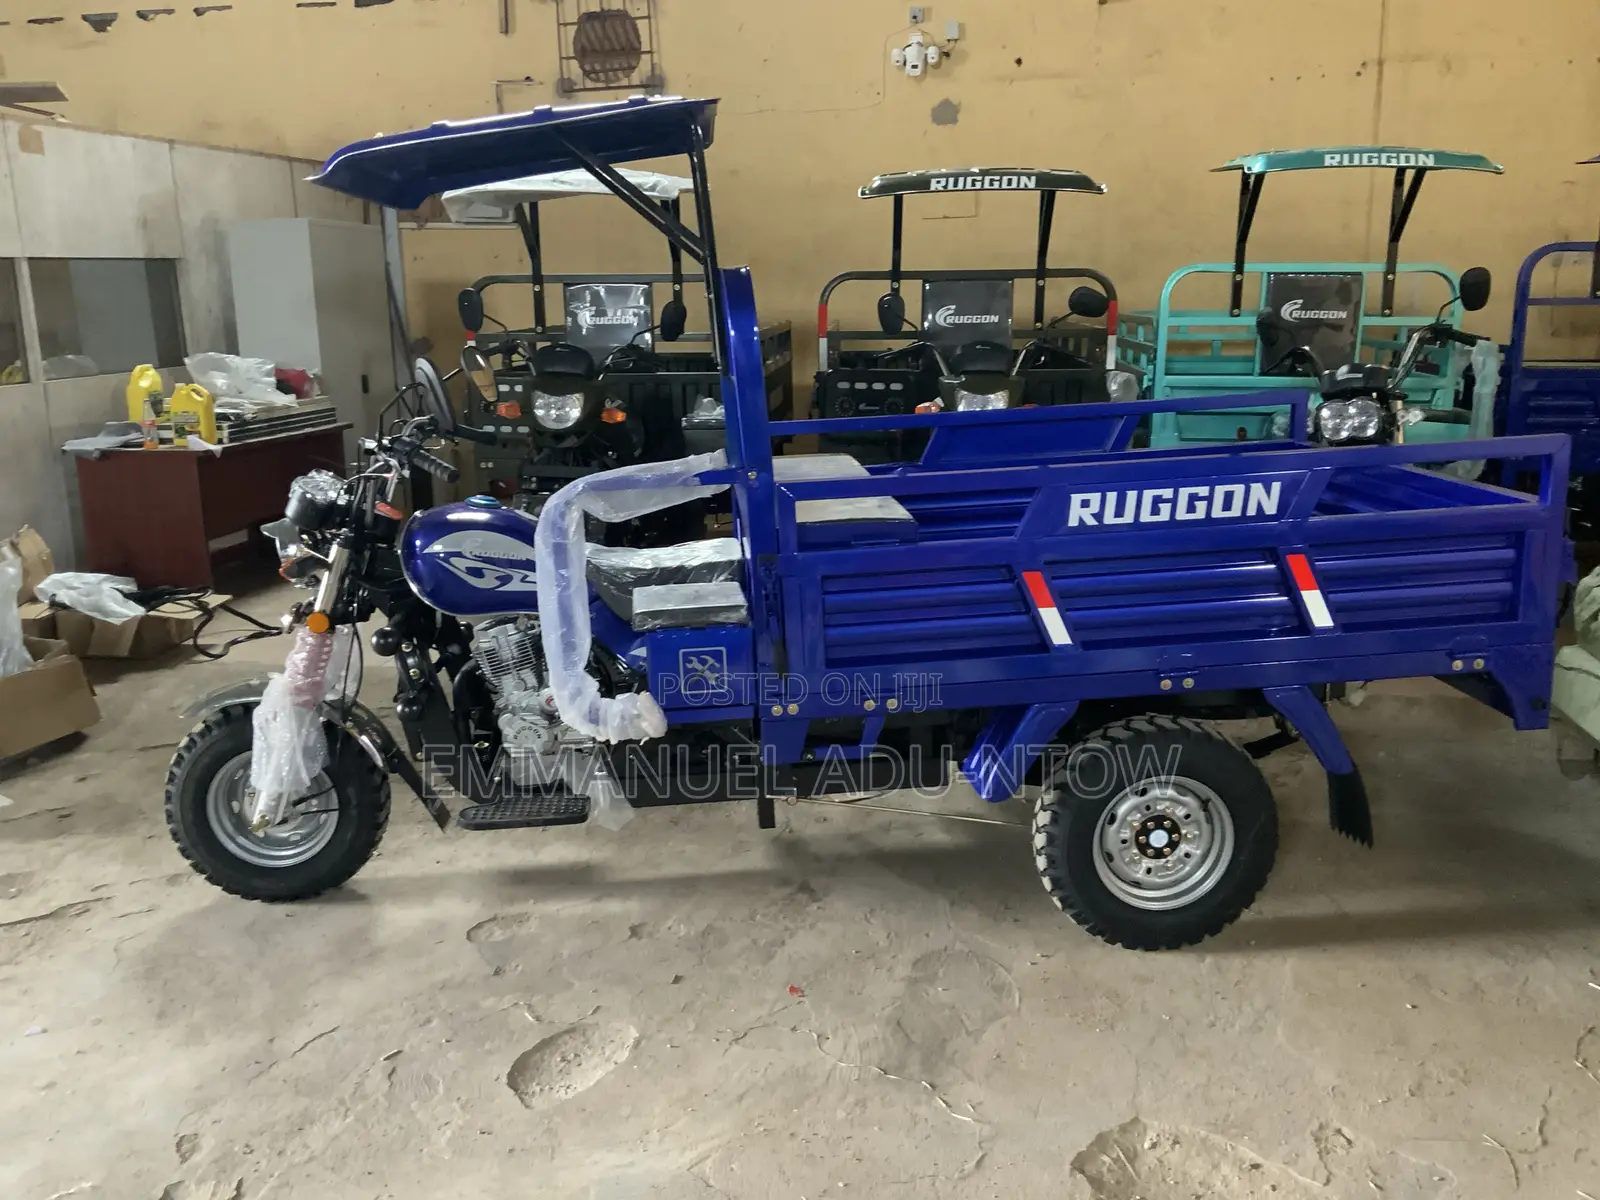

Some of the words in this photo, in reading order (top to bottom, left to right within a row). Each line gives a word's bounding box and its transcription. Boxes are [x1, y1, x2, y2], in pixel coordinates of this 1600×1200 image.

[1323, 153, 1435, 166] RUGGON
[929, 175, 1037, 191] RUGGON
[1067, 481, 1282, 527] RUGGON
